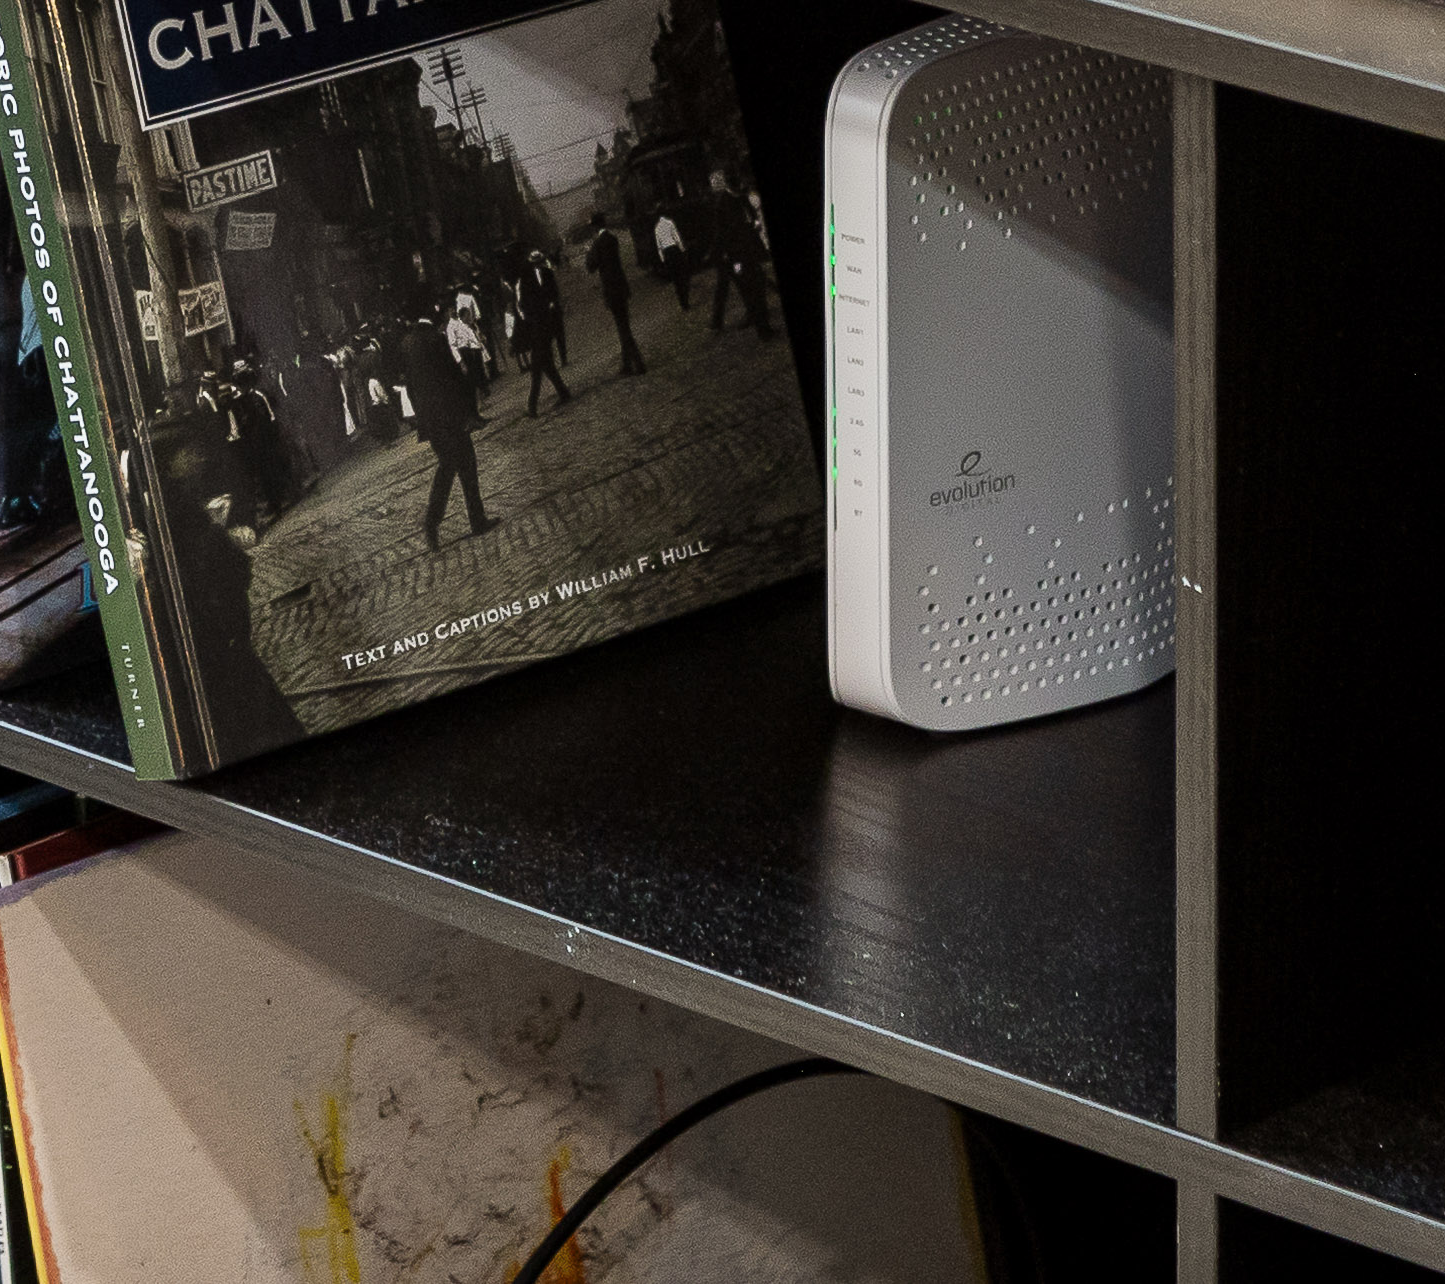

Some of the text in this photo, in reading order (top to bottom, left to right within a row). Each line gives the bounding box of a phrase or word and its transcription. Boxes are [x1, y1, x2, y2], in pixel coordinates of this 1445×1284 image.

[188, 157, 273, 206] PASTIME
[8, 127, 52, 271] PHOTOS
[41, 279, 64, 327] OF
[53, 335, 120, 597] CHATTANOOGA
[929, 473, 1016, 508] evolution
[637, 555, 656, 574] F.
[120, 642, 146, 731] TURNER
